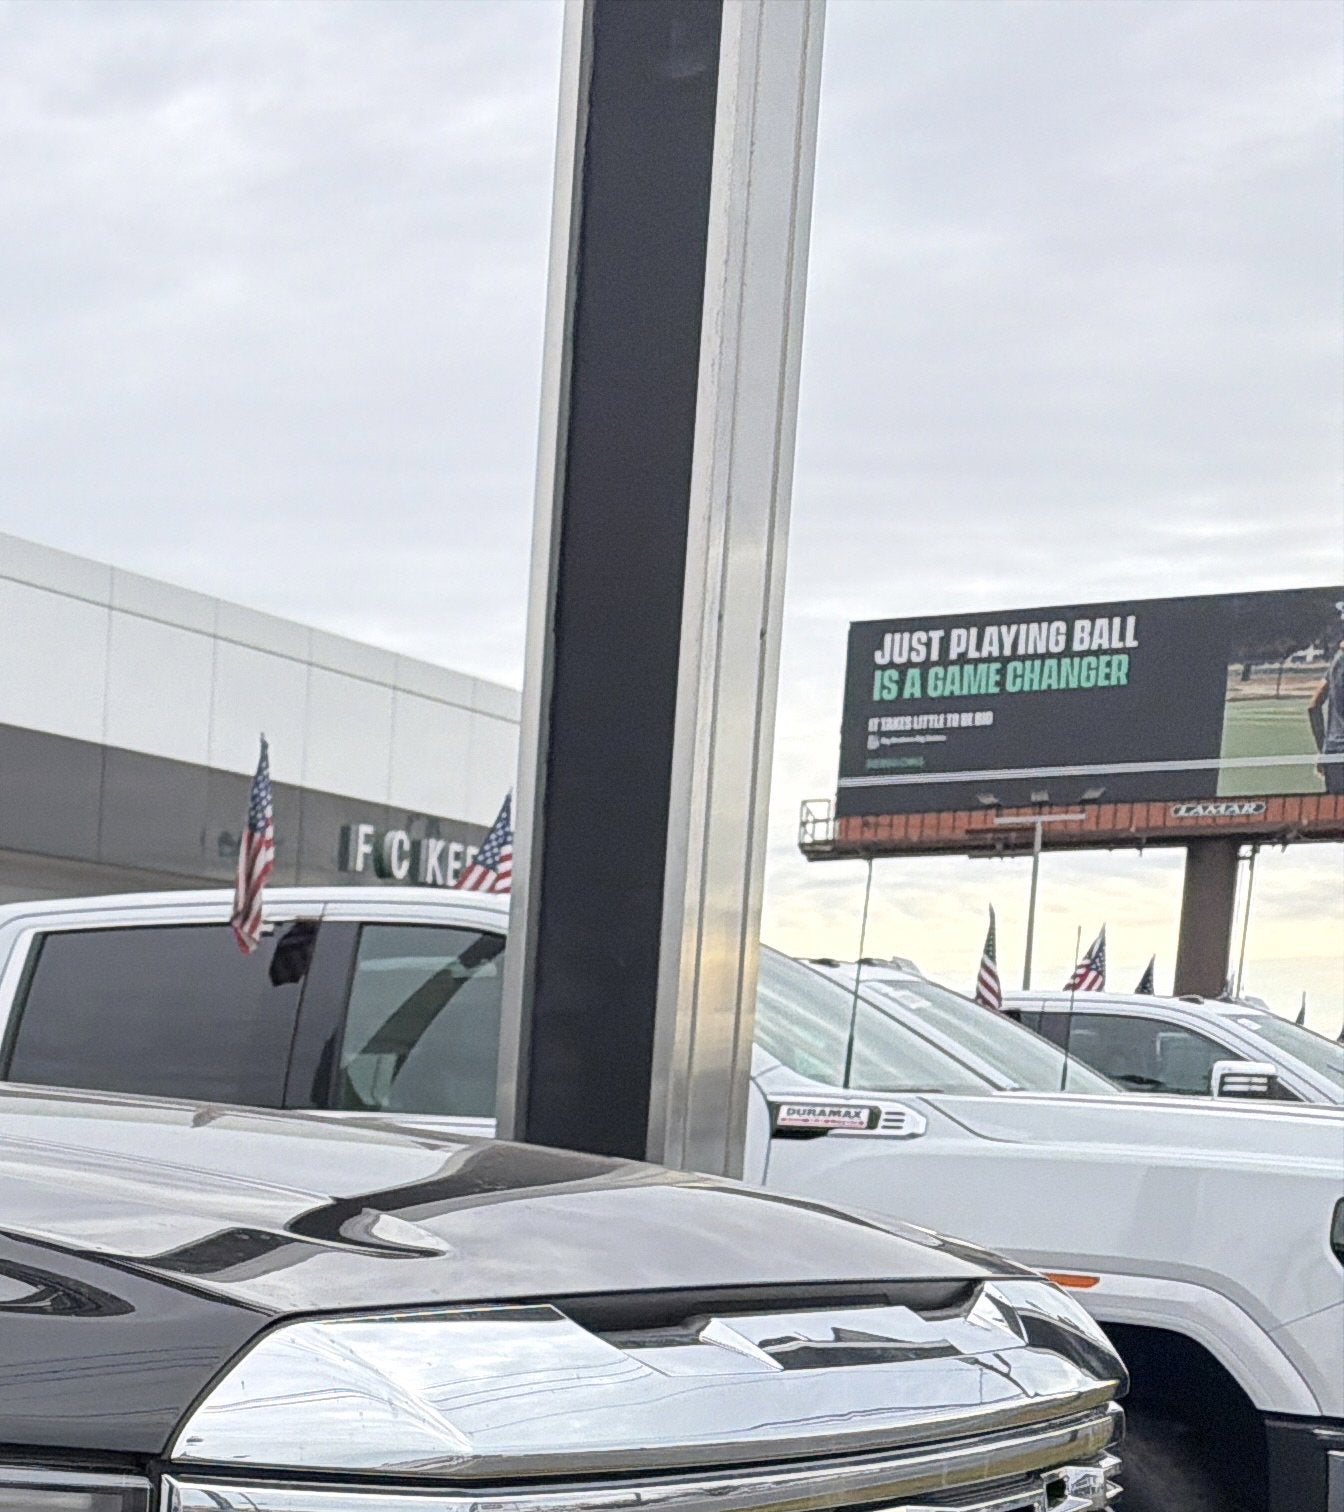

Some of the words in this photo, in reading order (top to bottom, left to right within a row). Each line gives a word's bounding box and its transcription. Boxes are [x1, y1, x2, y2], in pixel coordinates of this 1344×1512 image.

[874, 629, 945, 665] JUST
[948, 620, 1067, 661] PLAYING
[1072, 615, 1139, 652] BALL
[873, 668, 900, 701] IS
[902, 667, 923, 699] A
[927, 662, 1003, 698] GAME
[1005, 654, 1130, 693] CHANGER
[1178, 802, 1257, 816] LAMAR
[355, 823, 375, 872] F
[391, 829, 410, 880] C
[786, 1107, 862, 1119] DURAMAX
